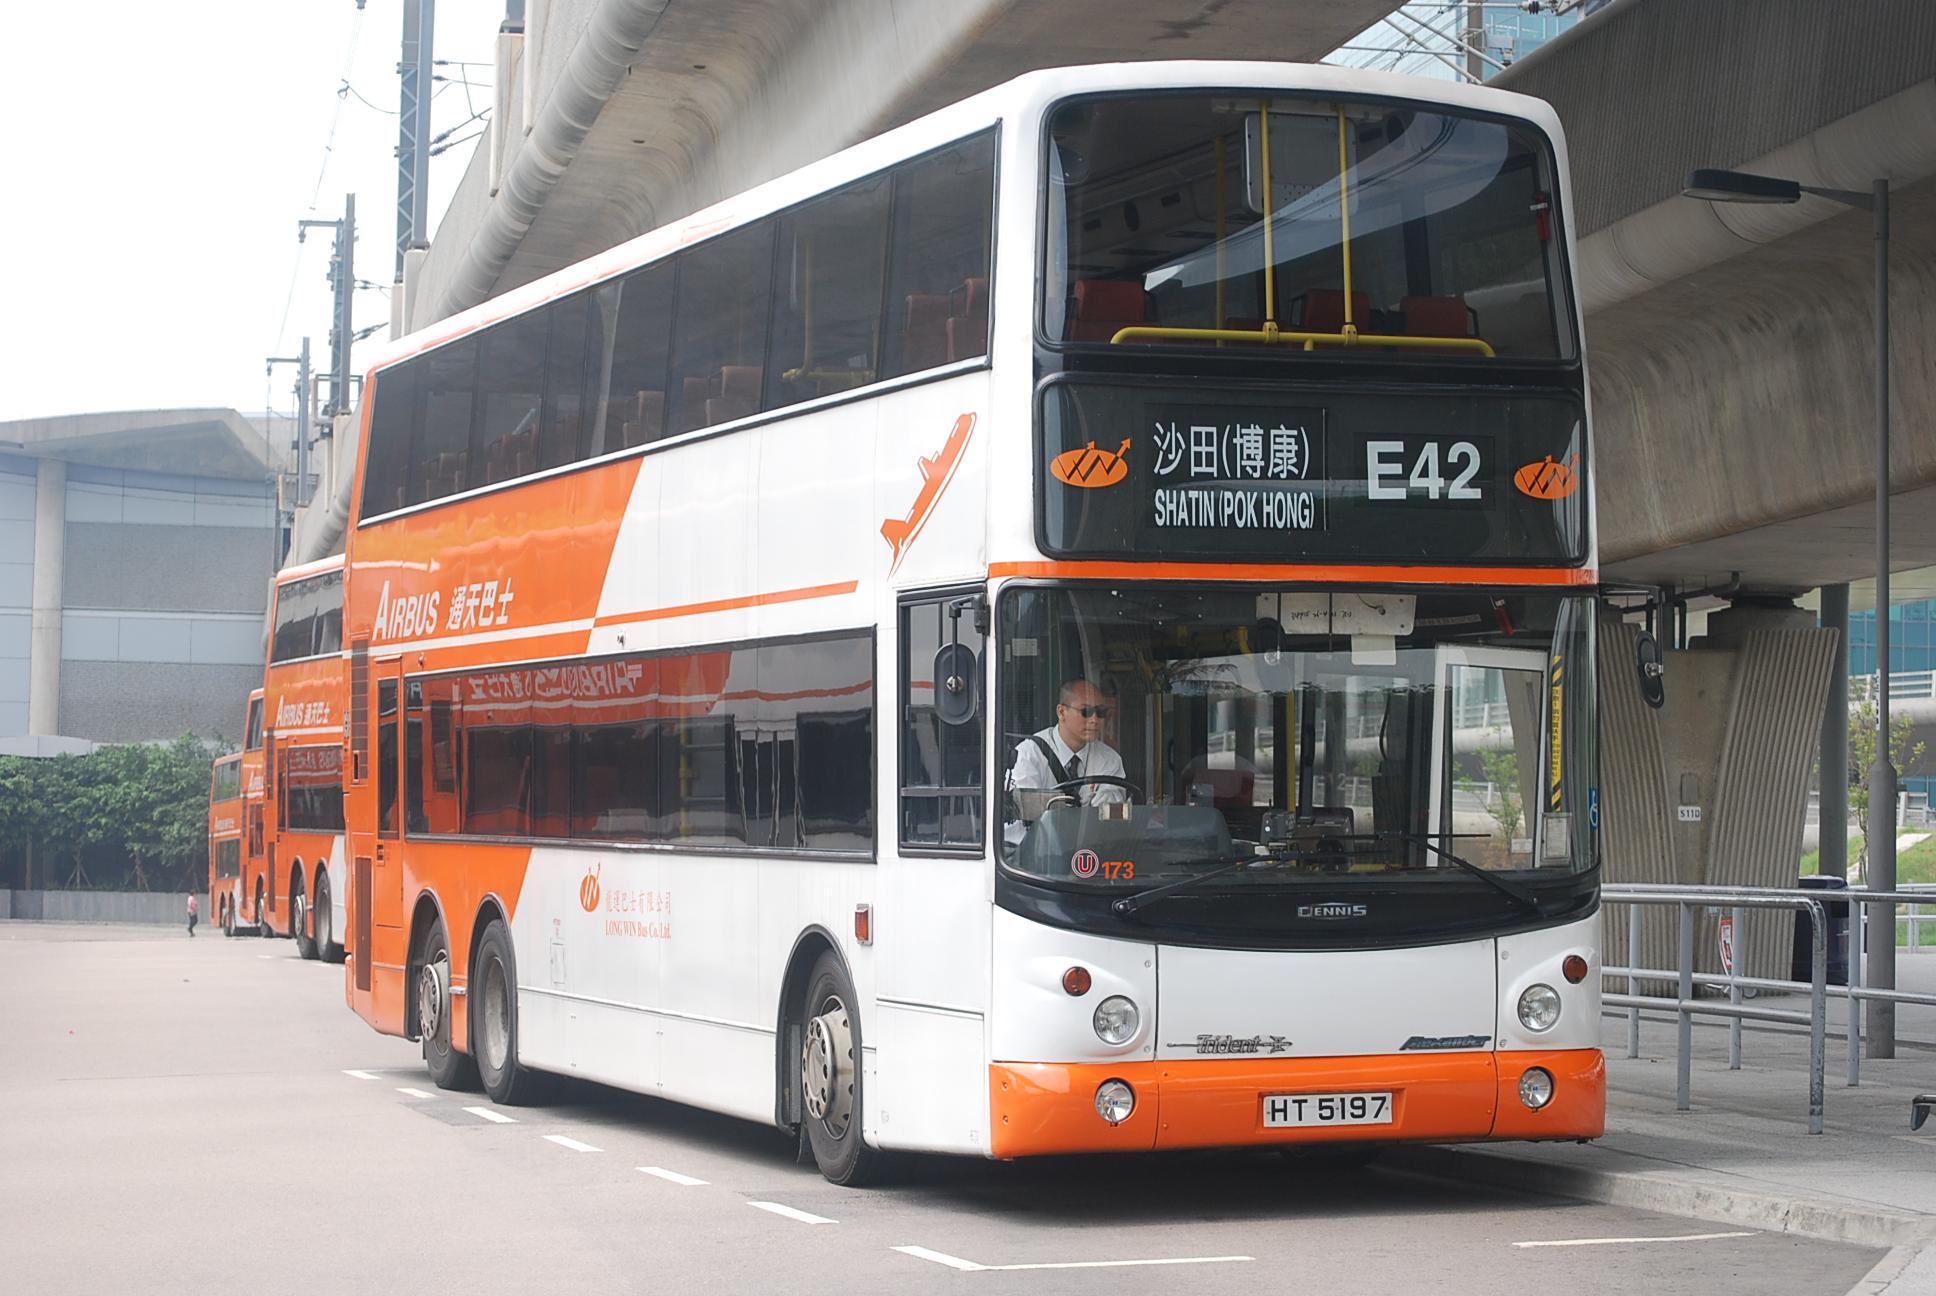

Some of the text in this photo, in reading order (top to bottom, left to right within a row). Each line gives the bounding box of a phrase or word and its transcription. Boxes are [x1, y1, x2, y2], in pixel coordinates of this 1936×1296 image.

[1153, 422, 1309, 479] 沙田(博康)
[1366, 441, 1482, 500] E42
[1155, 489, 1314, 529] SHATIN (POK HONG)
[372, 577, 514, 640] AIRBUS 通天巴士
[1102, 861, 1135, 880] 173
[1298, 905, 1367, 917] DENNIS
[605, 920, 622, 936] LONG
[624, 920, 636, 936] WIN
[1197, 1034, 1262, 1054] Trident
[1271, 1096, 1387, 1121] HT 5197
